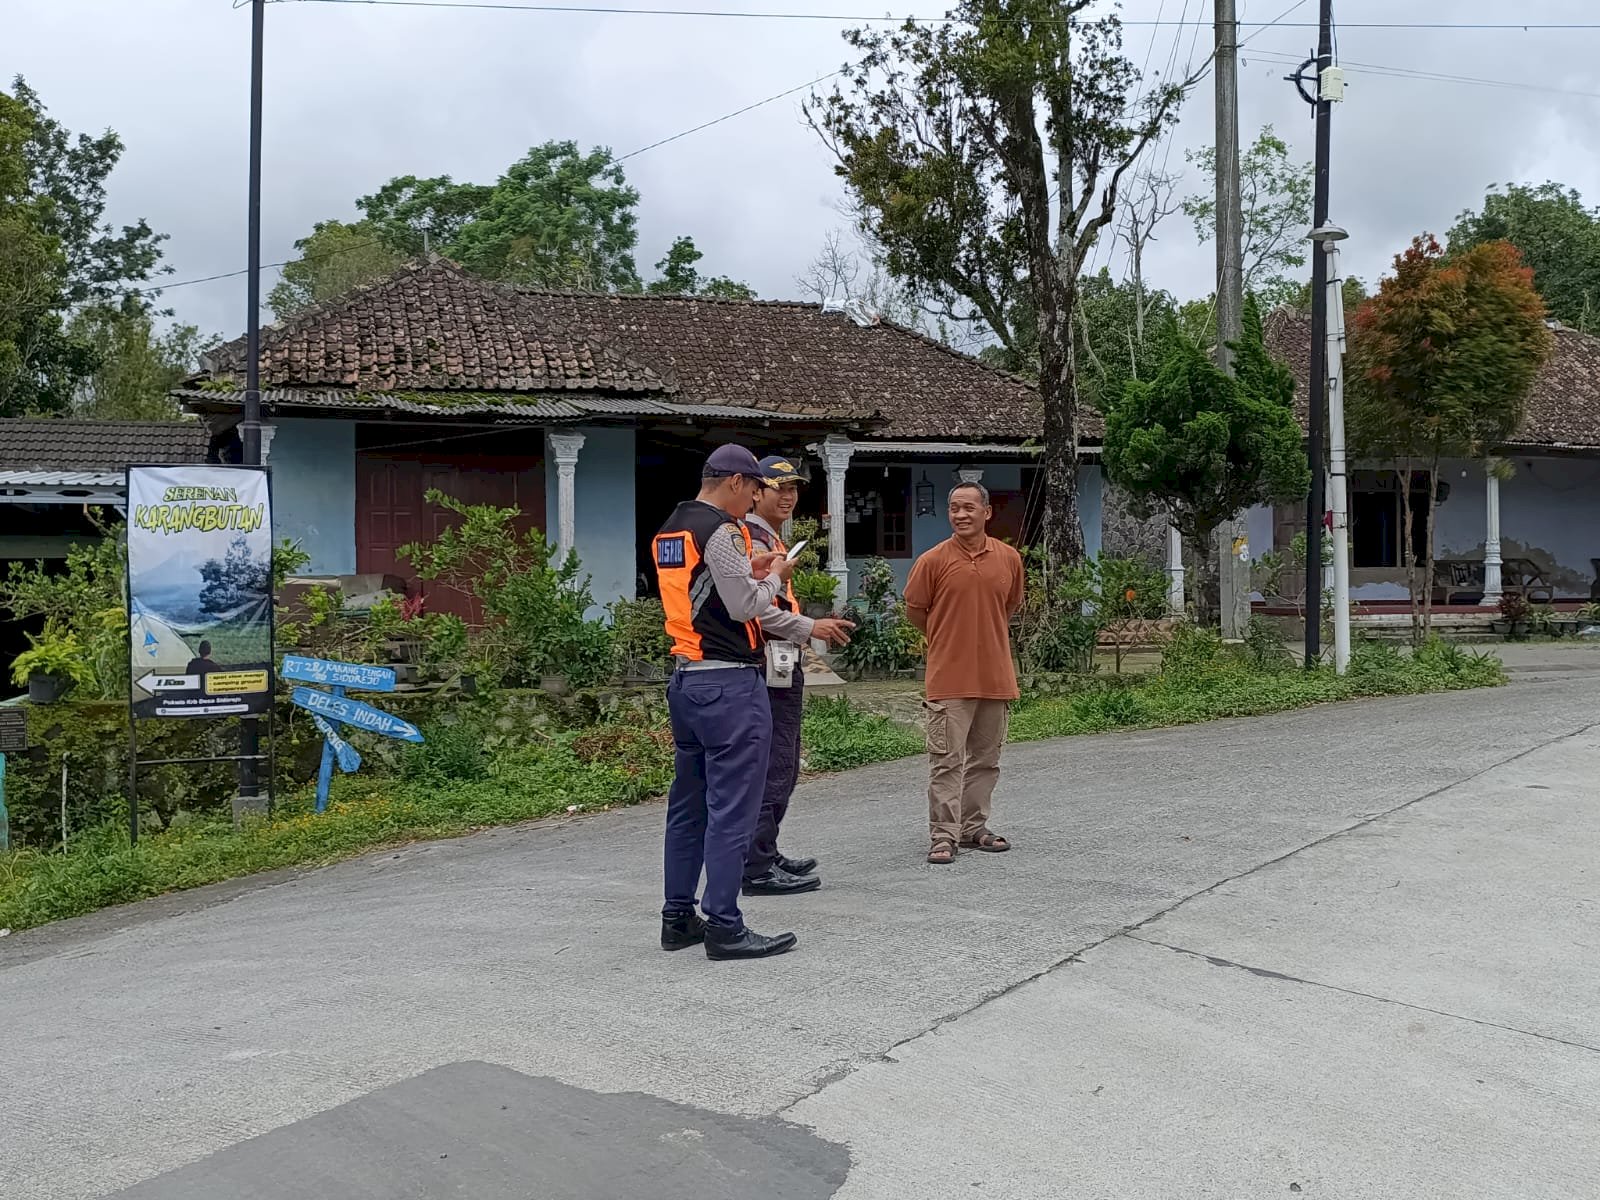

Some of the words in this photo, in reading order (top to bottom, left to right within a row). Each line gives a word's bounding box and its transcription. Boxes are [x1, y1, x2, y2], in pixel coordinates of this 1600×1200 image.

[163, 486, 237, 502] SERENAN
[134, 502, 264, 536] KARANGBUTAN
[285, 660, 304, 673] RT
[307, 692, 350, 717] DELES
[353, 708, 393, 731] INDAH
